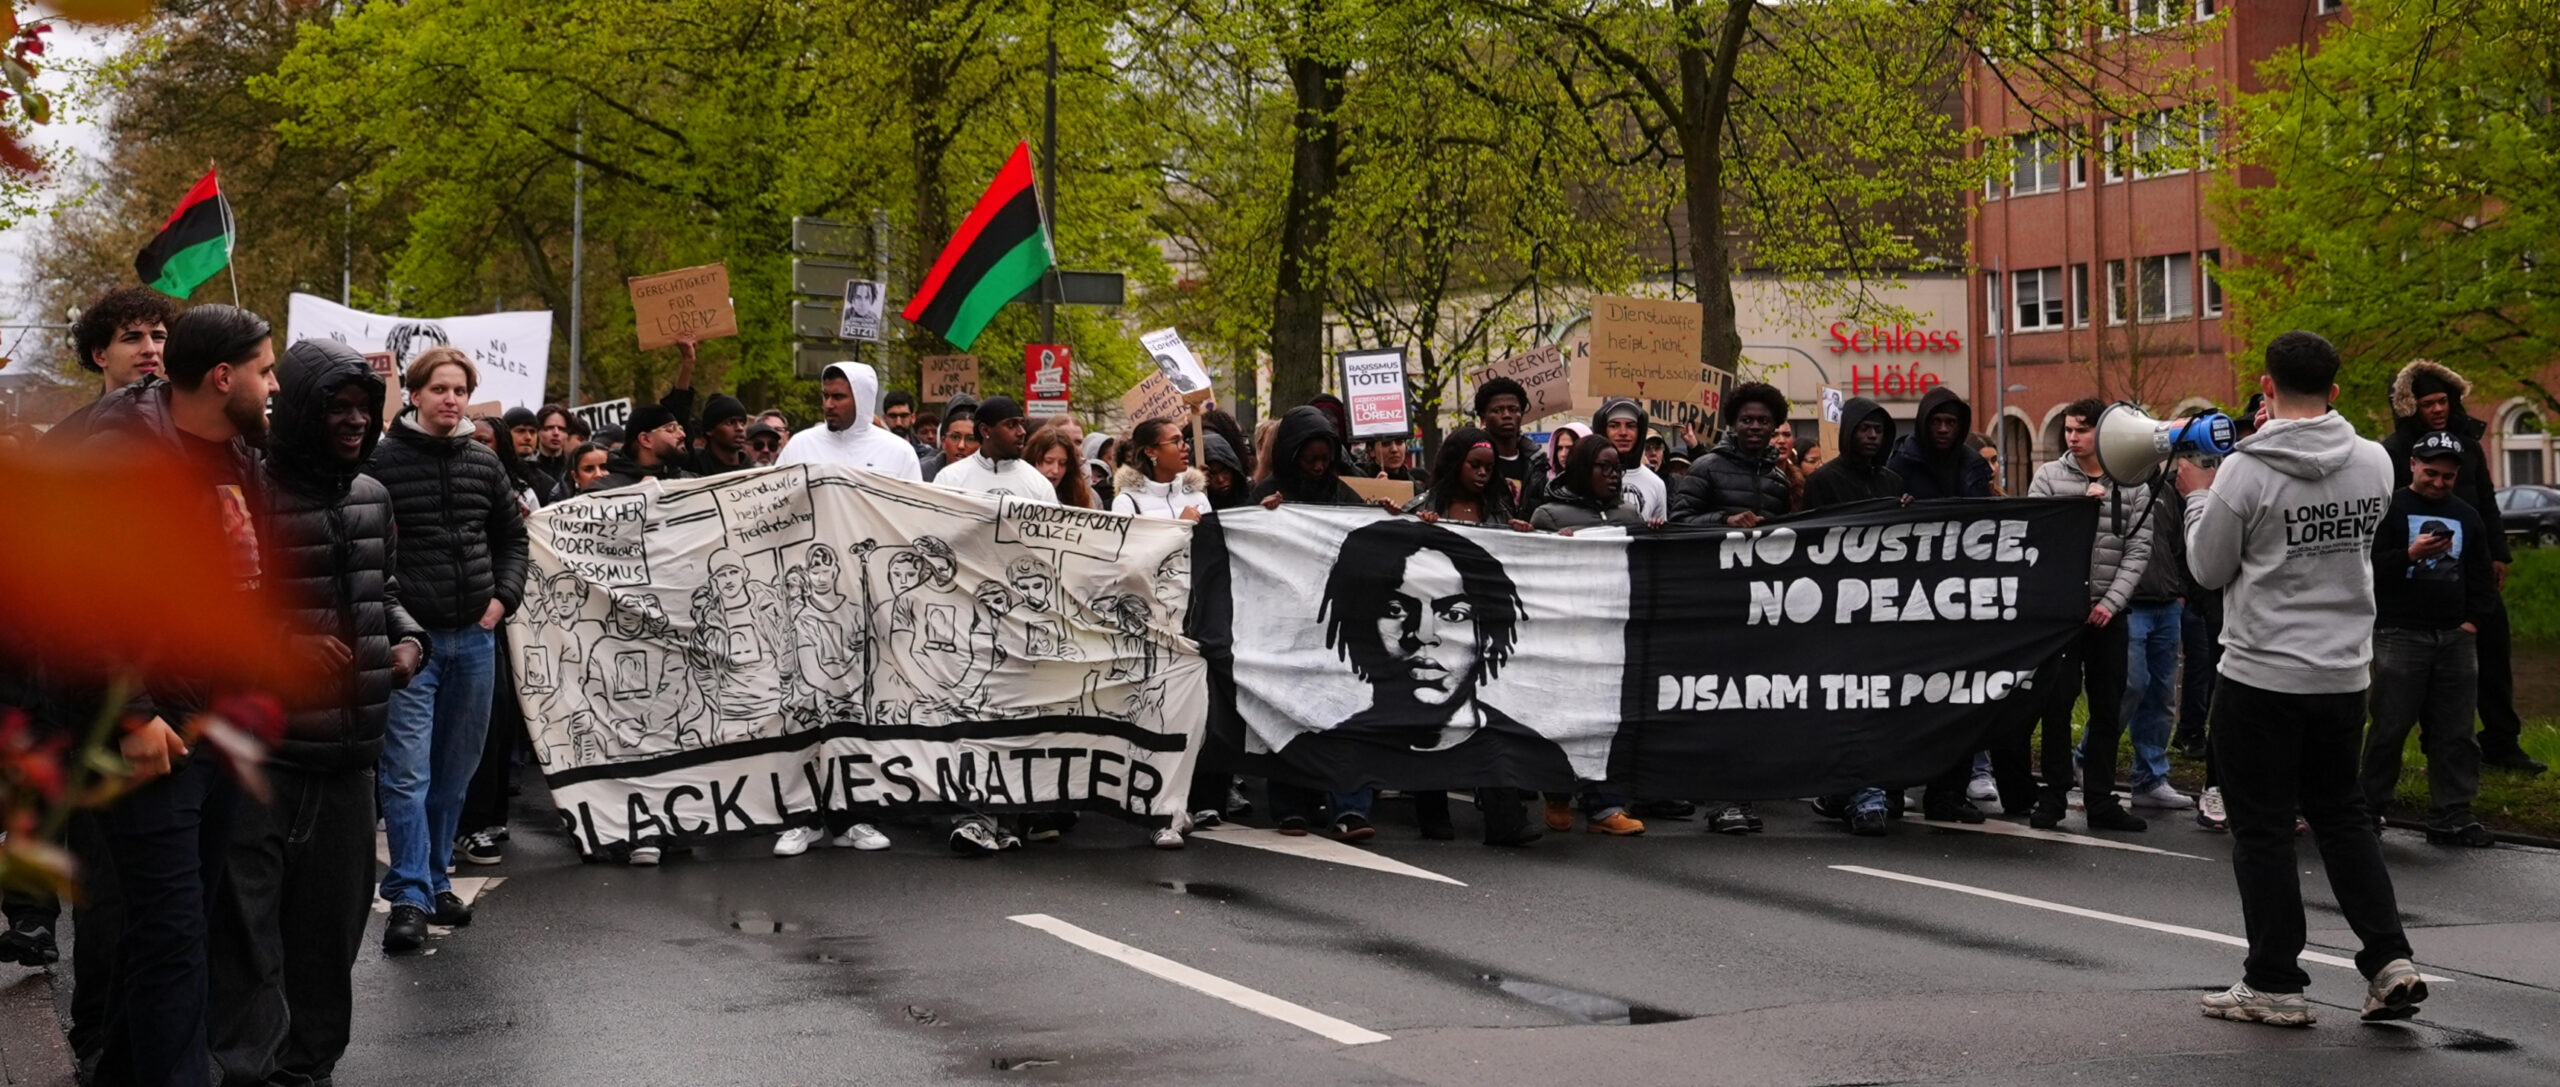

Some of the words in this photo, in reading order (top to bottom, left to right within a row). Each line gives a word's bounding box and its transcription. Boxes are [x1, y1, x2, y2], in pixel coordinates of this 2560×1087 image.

[635, 272, 718, 298] GERECHTIGKEIT
[668, 294, 695, 310] FÜR
[656, 309, 718, 337] LORENZ
[1606, 303, 1695, 331] Dienstwaffe
[490, 339, 507, 354] NO
[1830, 321, 1961, 353] Schloss
[475, 349, 529, 377] PEACE
[930, 358, 971, 371] JUSTICE
[1473, 367, 1498, 385] TO
[1507, 347, 1561, 375] SERVE
[930, 382, 976, 397] LORENZ
[1349, 369, 1400, 386] TÖTET
[1851, 362, 1940, 395] Höfe
[571, 402, 628, 432] TICE
[1356, 409, 1403, 421] LORENZ
[1639, 399, 1717, 438] NIFORM
[2284, 502, 2339, 524] LONG
[2344, 497, 2381, 517] LIVE
[1018, 520, 1082, 545] POLIZEI
[1720, 527, 1797, 569] NO
[1807, 519, 2040, 568] JUSTICE,
[2286, 515, 2378, 546] LORENZ
[555, 537, 594, 556] ODER
[1747, 577, 1823, 626] NO
[1835, 576, 2020, 624] PEACE!
[1657, 672, 1807, 711] DISARM
[1820, 673, 1891, 711] THE
[936, 747, 1164, 816] MATTER
